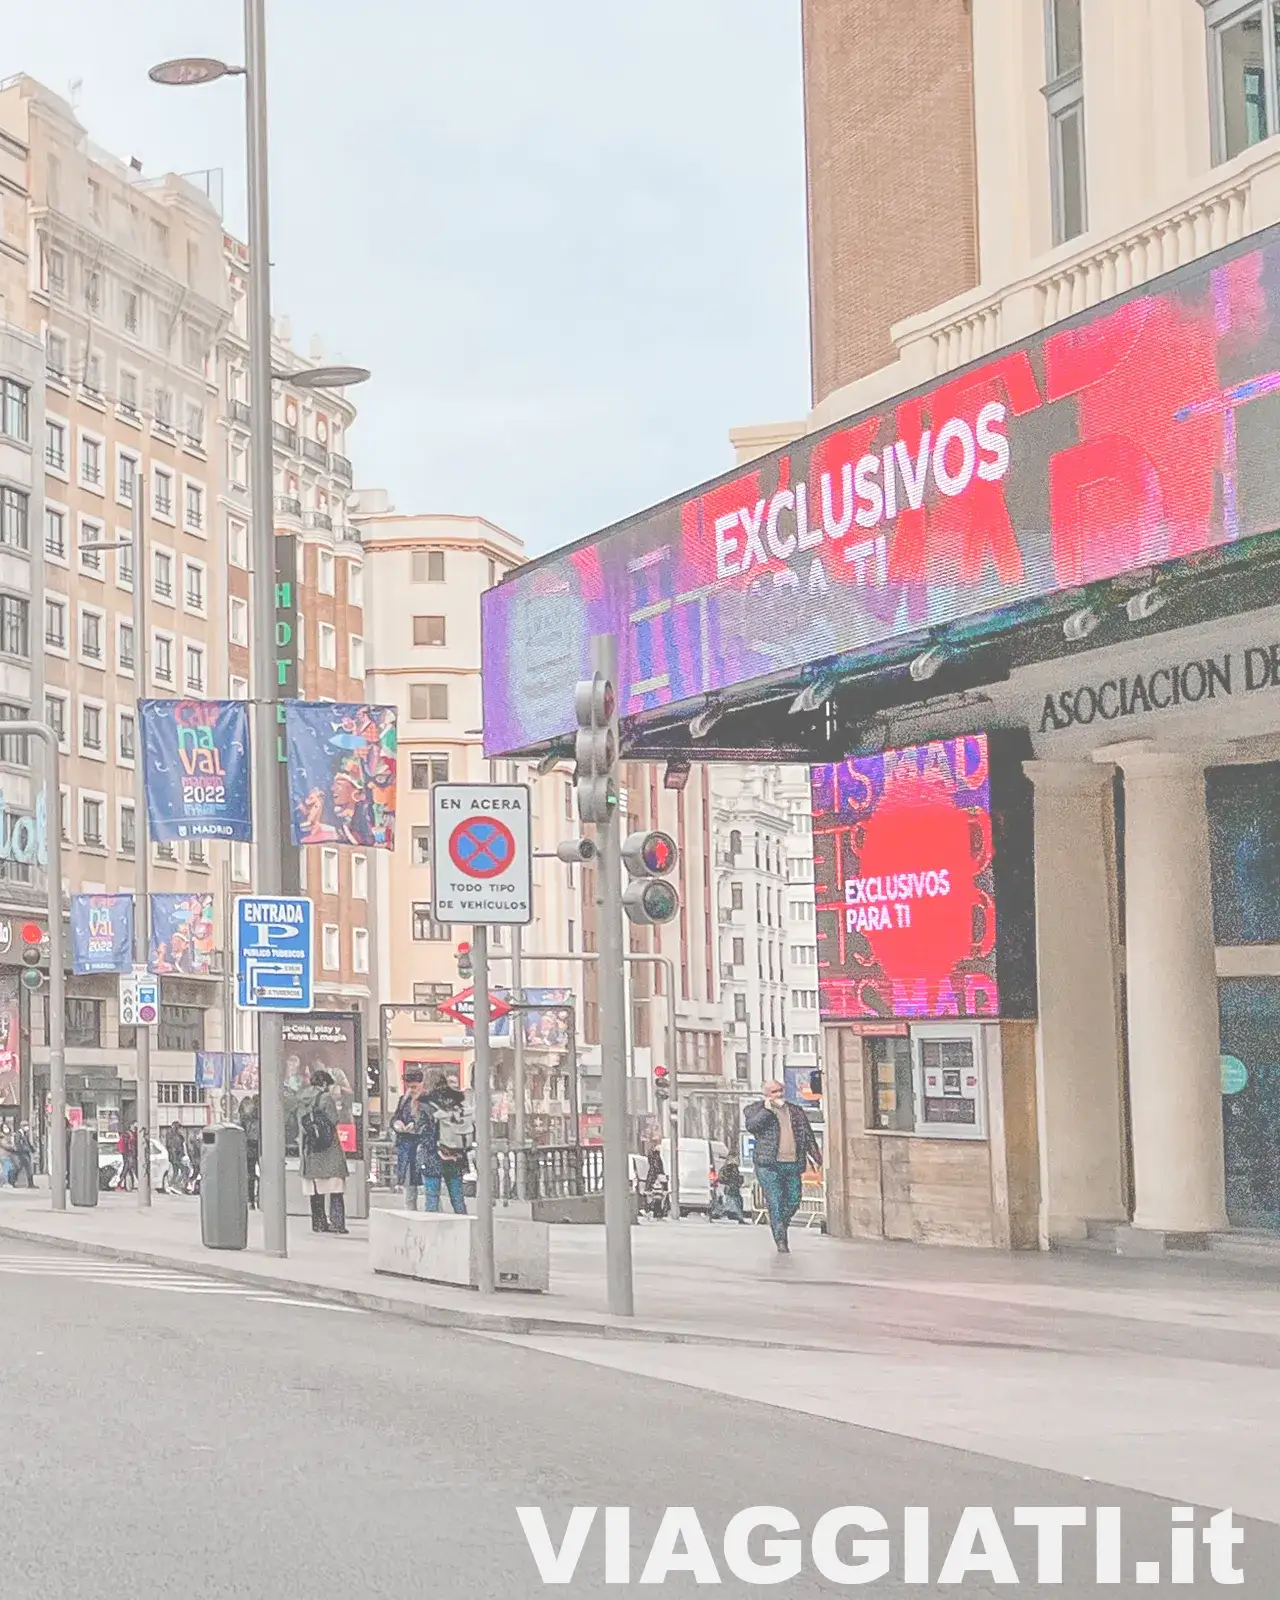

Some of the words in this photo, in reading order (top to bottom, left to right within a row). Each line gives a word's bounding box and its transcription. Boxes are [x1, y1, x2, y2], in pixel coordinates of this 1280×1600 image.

[714, 401, 1010, 580] EXCLUSIVOS
[274, 582, 292, 763] HOTEL
[1039, 653, 1232, 733] ASOCIACION
[177, 725, 215, 750] na
[183, 786, 226, 803] 2022
[441, 799, 461, 809] EN
[471, 799, 521, 810] ACERA
[192, 825, 234, 836] MADRID
[450, 883, 482, 892] TODO
[490, 884, 515, 893] TIPO
[845, 869, 951, 903] EXCLUSIVOS
[244, 903, 304, 924] ENTRADA
[439, 900, 454, 909] DE
[460, 899, 527, 910] VEHÍCULOS
[846, 906, 892, 932] PARA
[893, 903, 911, 929] TI
[88, 940, 113, 952] 2022
[249, 923, 299, 948] P
